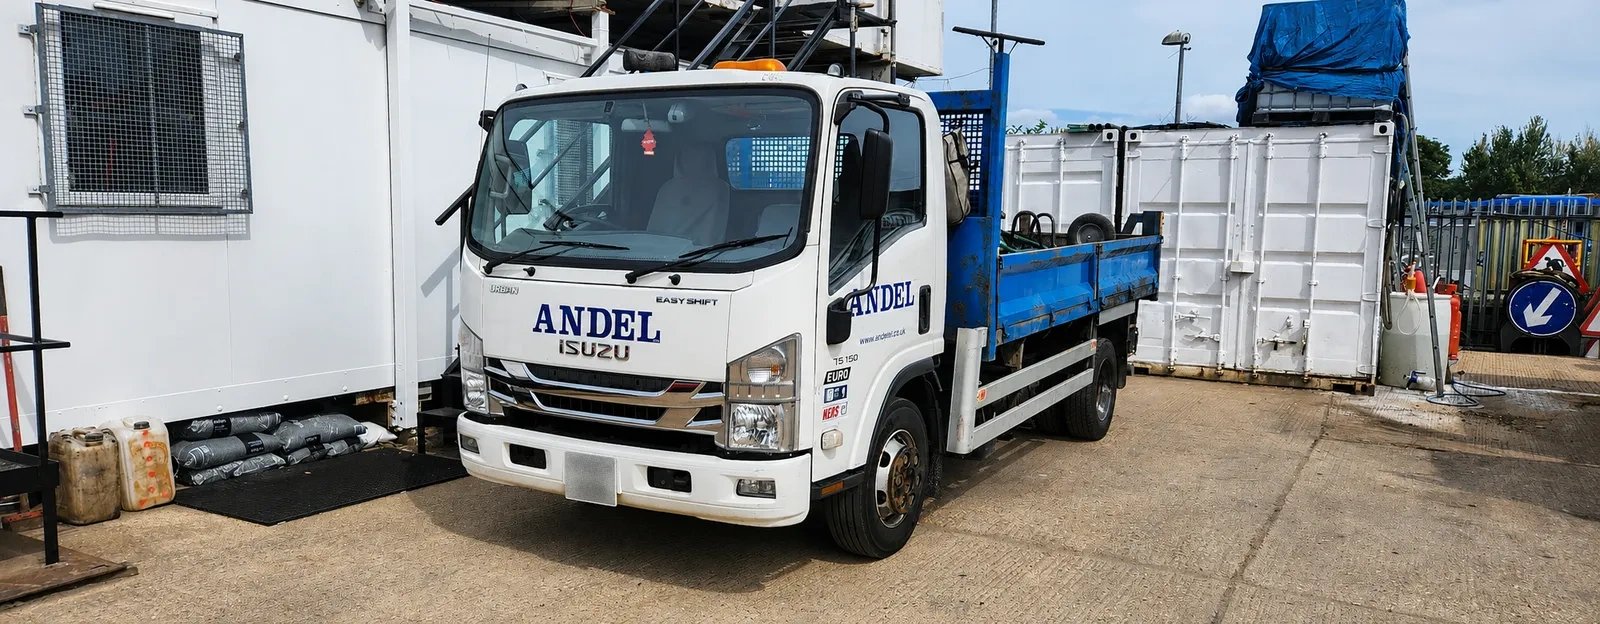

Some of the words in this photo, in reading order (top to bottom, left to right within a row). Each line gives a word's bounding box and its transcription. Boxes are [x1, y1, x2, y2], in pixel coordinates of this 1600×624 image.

[489, 285, 519, 295] URBAN
[656, 296, 686, 304] EASY
[687, 298, 718, 306] SHIFT
[851, 281, 914, 317] ANDEL
[532, 303, 661, 343] ANDEL
[559, 339, 631, 361] ISUZU
[845, 353, 859, 363] 150
[826, 368, 849, 383] EURO
